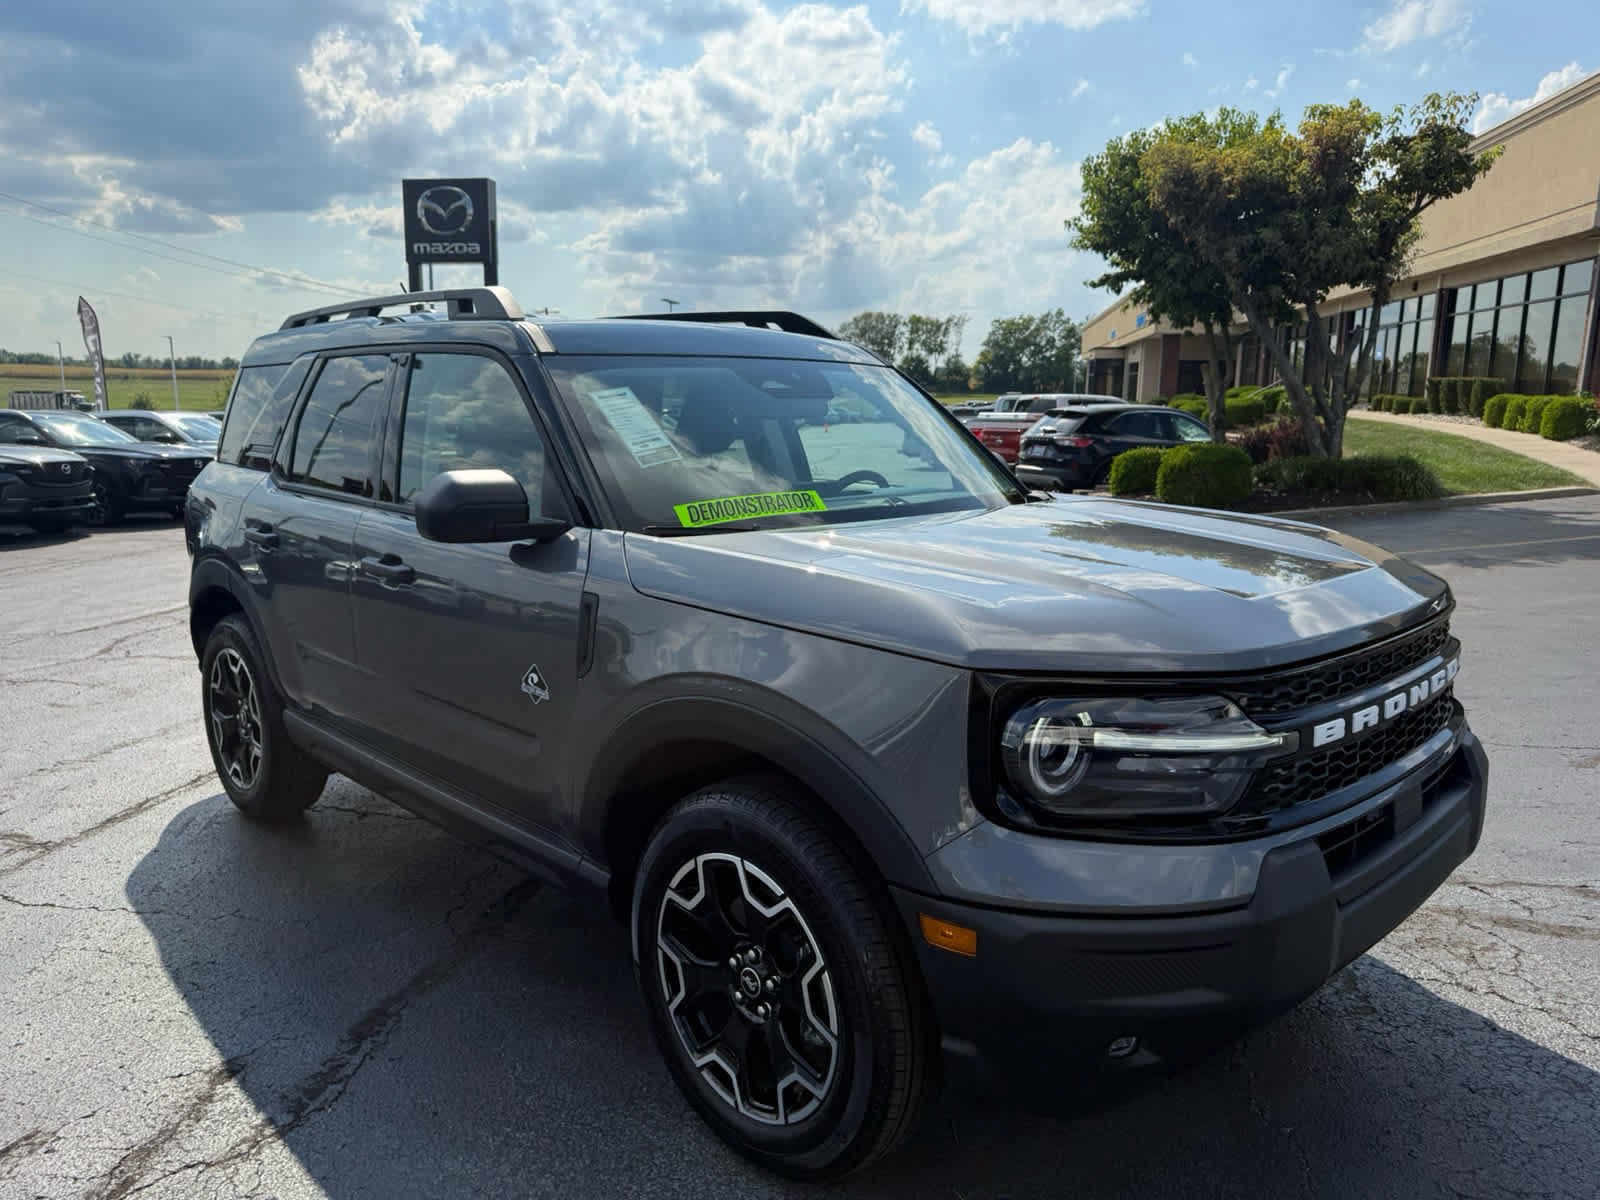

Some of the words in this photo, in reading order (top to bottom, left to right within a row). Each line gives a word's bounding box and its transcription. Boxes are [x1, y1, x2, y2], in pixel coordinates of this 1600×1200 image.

[413, 242, 481, 254] mazda
[686, 492, 816, 524] DEMONSTRATOR
[1313, 658, 1458, 748] BRONCO
